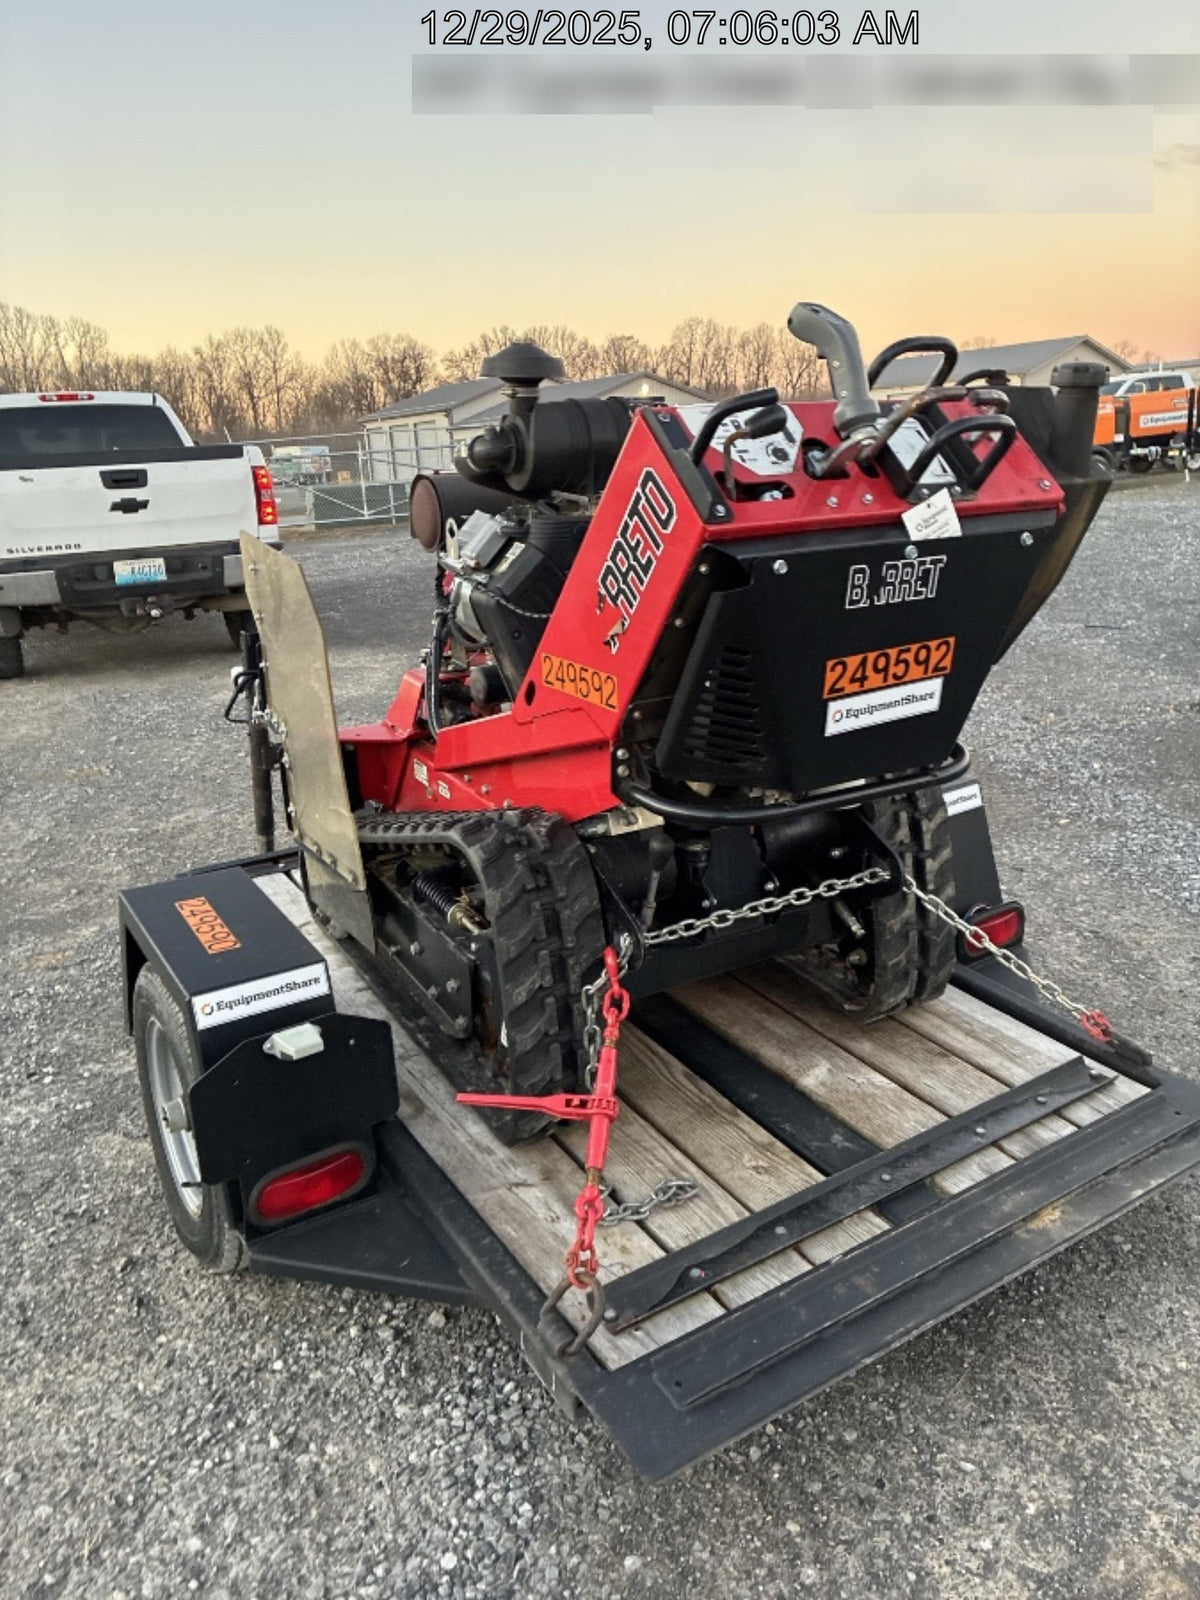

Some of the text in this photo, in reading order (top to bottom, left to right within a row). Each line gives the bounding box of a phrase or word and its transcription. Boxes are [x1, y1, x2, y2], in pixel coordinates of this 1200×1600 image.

[6, 543, 82, 554] SILVERADO
[543, 655, 616, 710] 249592
[826, 639, 952, 696] 249592
[844, 690, 935, 719] EquipmentShare
[176, 898, 238, 952] 249590
[215, 976, 321, 1012] EquipmentShare
